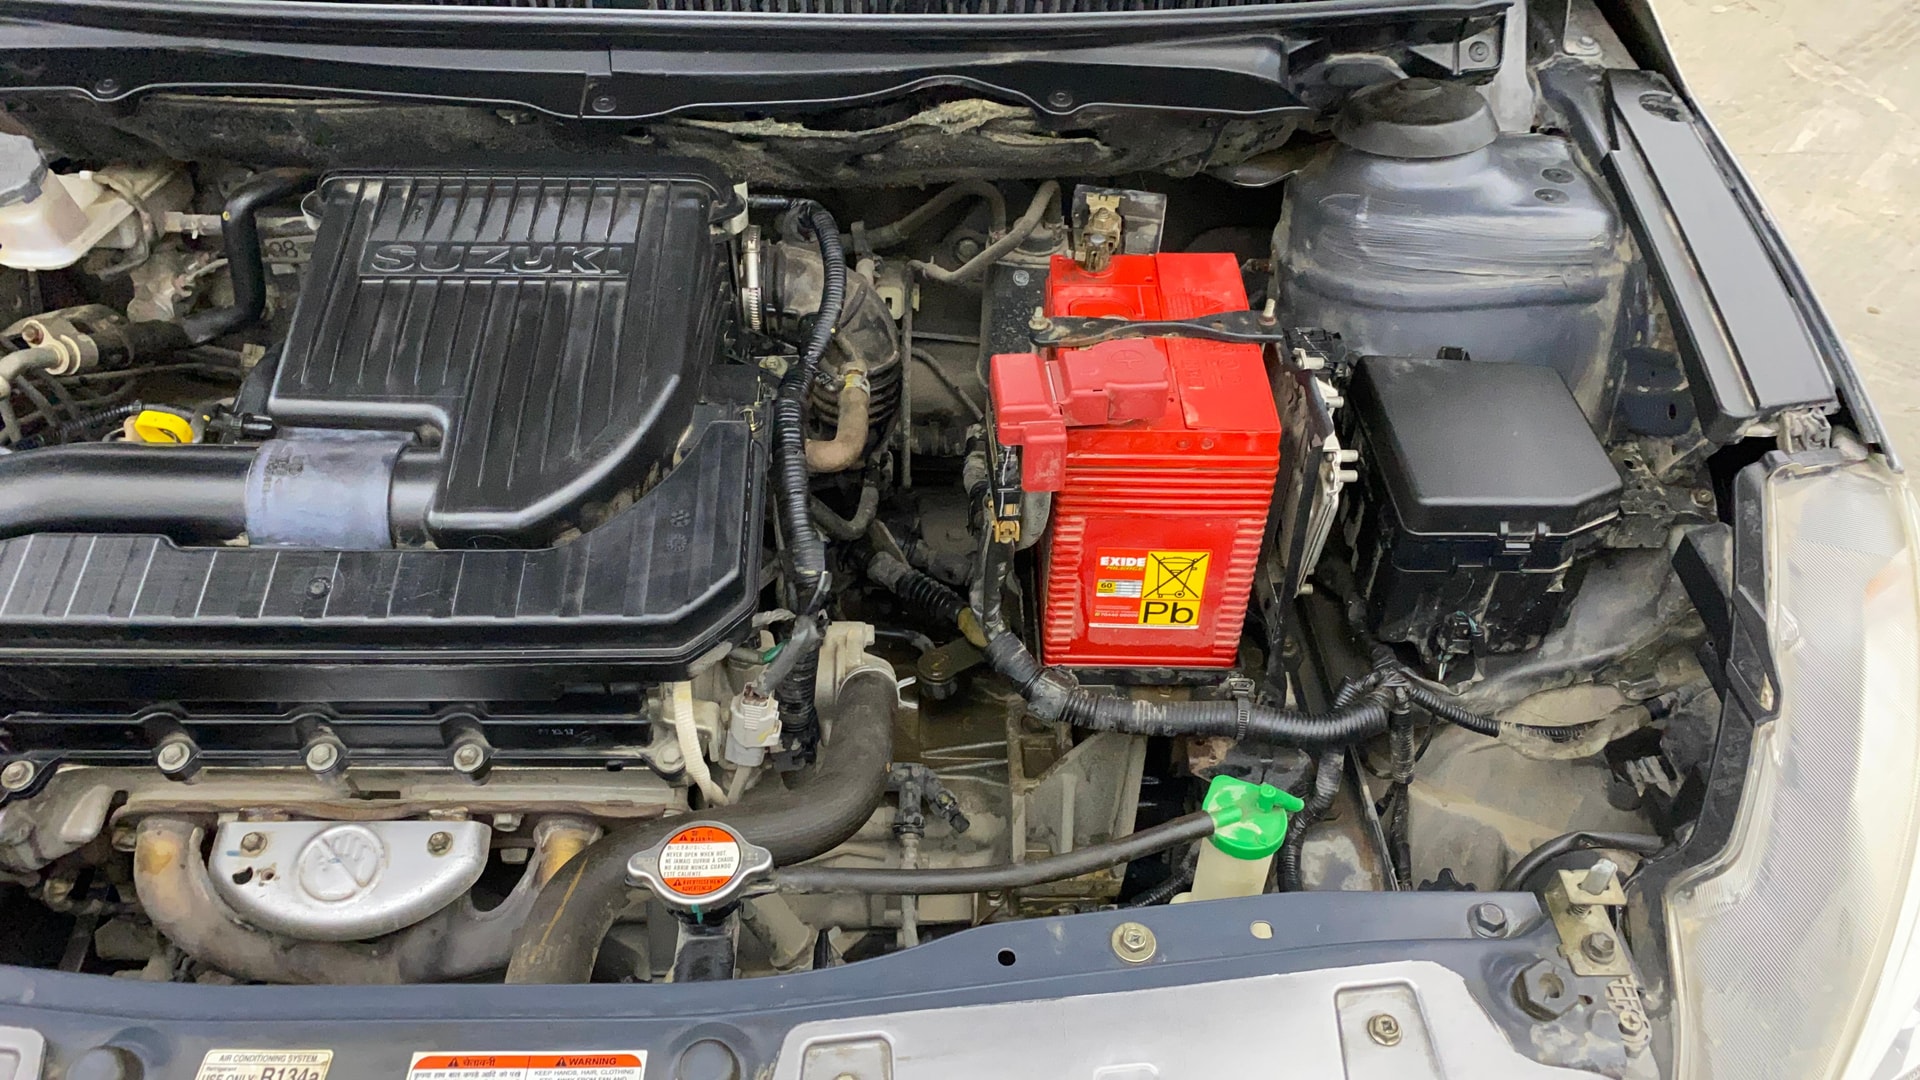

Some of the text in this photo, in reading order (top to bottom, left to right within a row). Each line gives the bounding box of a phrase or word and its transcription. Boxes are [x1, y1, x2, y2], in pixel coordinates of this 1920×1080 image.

[371, 245, 622, 273] SUZUKI
[1100, 556, 1146, 566] EXIDE
[1143, 602, 1194, 624] Pb
[569, 1057, 617, 1066] WARNING
[259, 1067, 320, 1080] R134a
